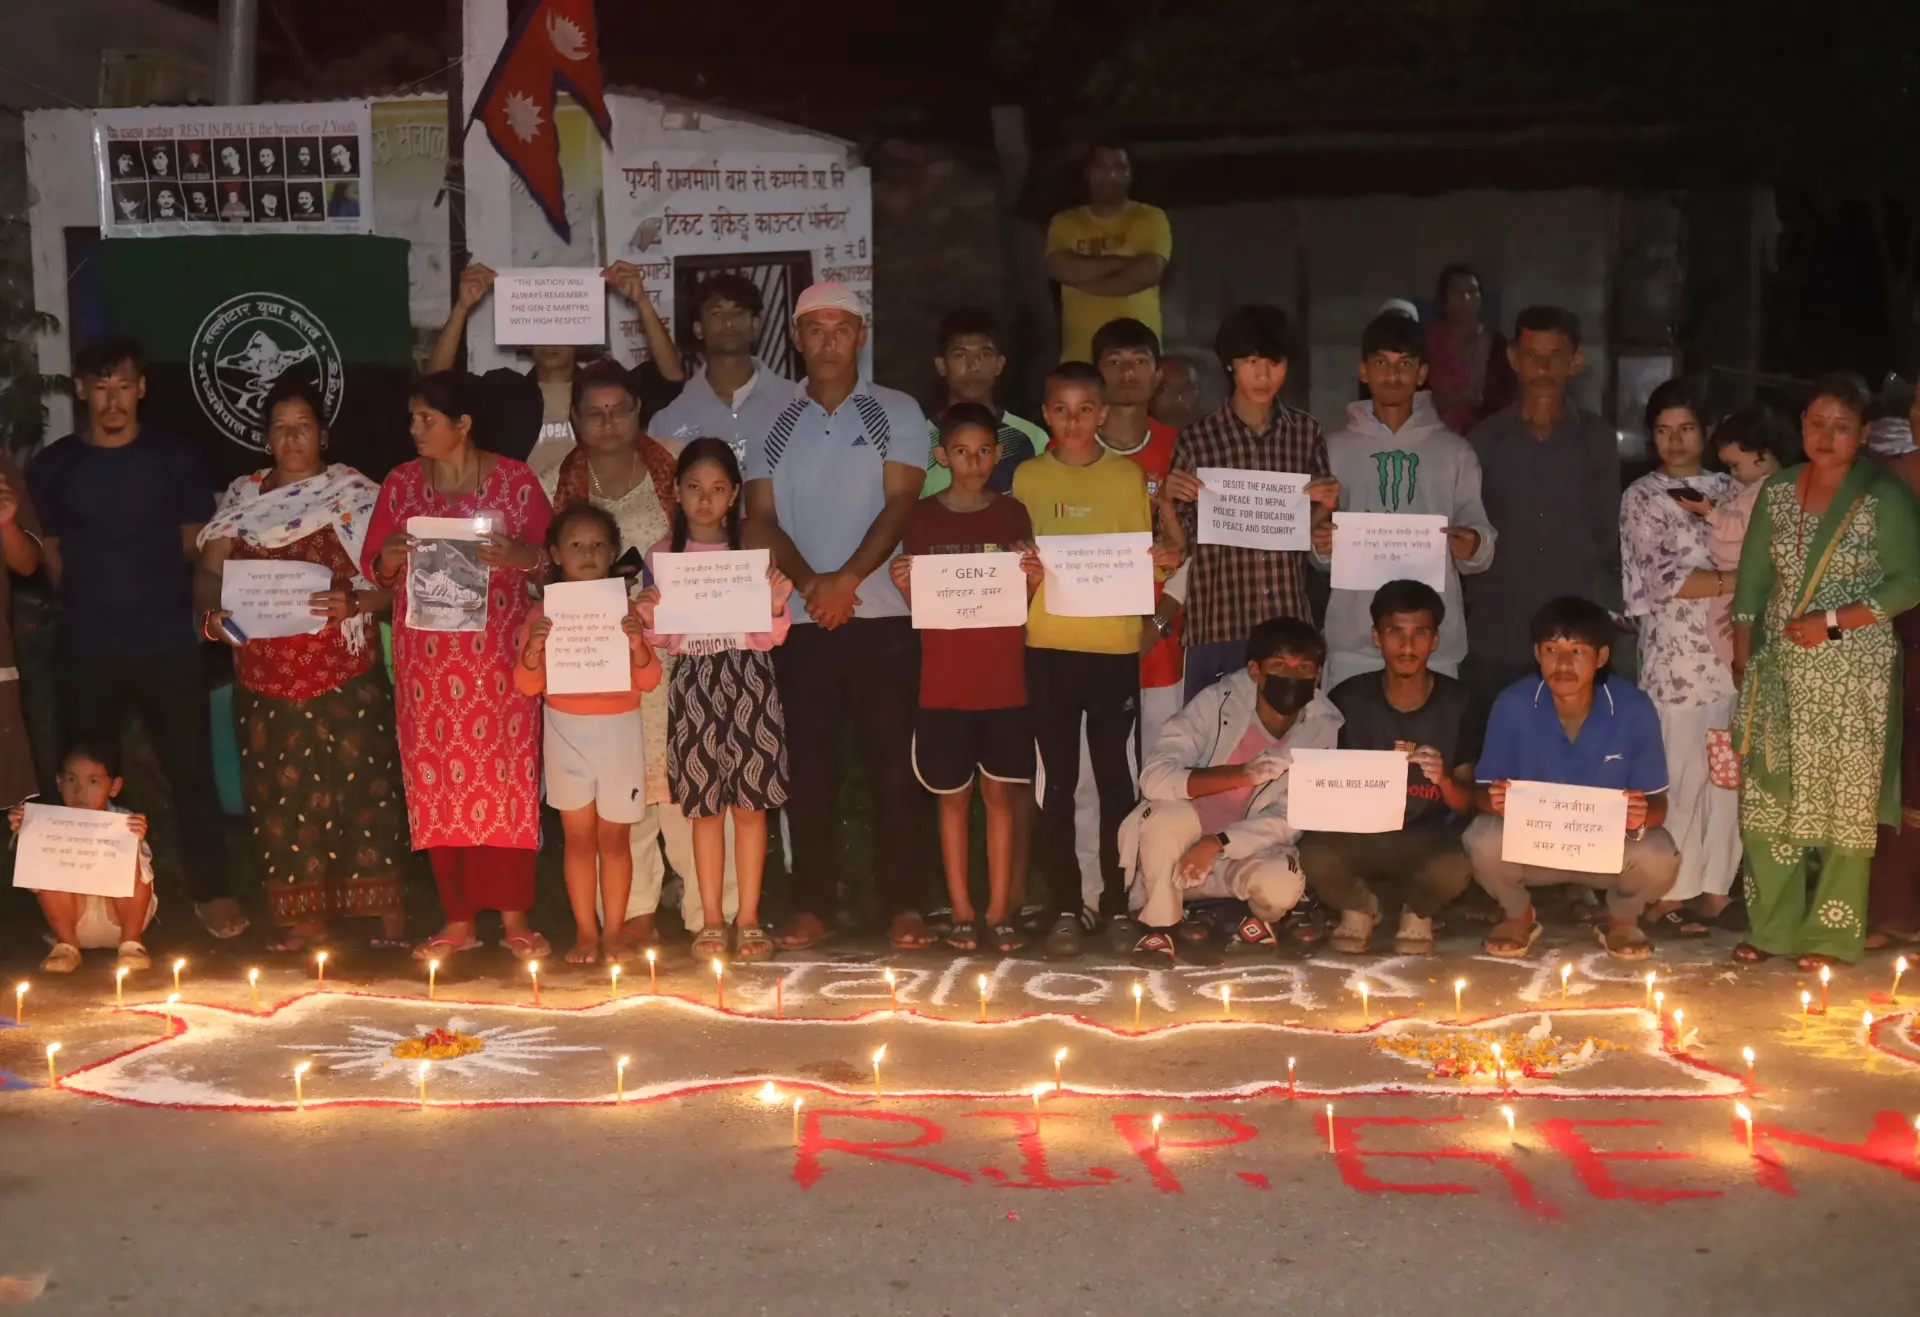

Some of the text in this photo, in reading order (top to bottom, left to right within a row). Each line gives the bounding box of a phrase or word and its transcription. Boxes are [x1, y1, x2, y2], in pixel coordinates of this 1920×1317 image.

[180, 124, 206, 138] REST
[209, 124, 220, 137] IN
[222, 122, 257, 137] PEACE
[259, 122, 273, 135] the
[301, 120, 320, 134] Gen
[323, 120, 329, 133] Z
[330, 119, 358, 133] Youth
[667, 160, 720, 191] राजमार्ग
[664, 206, 703, 236] टिकट
[534, 278, 565, 286] NATION
[544, 291, 589, 299] REMEMBER
[510, 317, 531, 325] WITH
[533, 317, 553, 325] HIGH
[1222, 480, 1245, 490] DESITE
[1247, 481, 1260, 491] THE
[1220, 494, 1287, 507] IN PEACE TO NEPAL
[1213, 506, 1295, 521] POLICE FOR DEDICATION
[1212, 519, 1221, 529] TO
[1222, 521, 1244, 532] PEACE
[1245, 524, 1260, 533] AND
[955, 567, 997, 579] GEN-Z
[980, 588, 1002, 597] अमर
[1315, 779, 1326, 788] WE
[1328, 779, 1344, 788] WILL
[1346, 780, 1362, 788] RISE
[1408, 784, 1442, 802] otify
